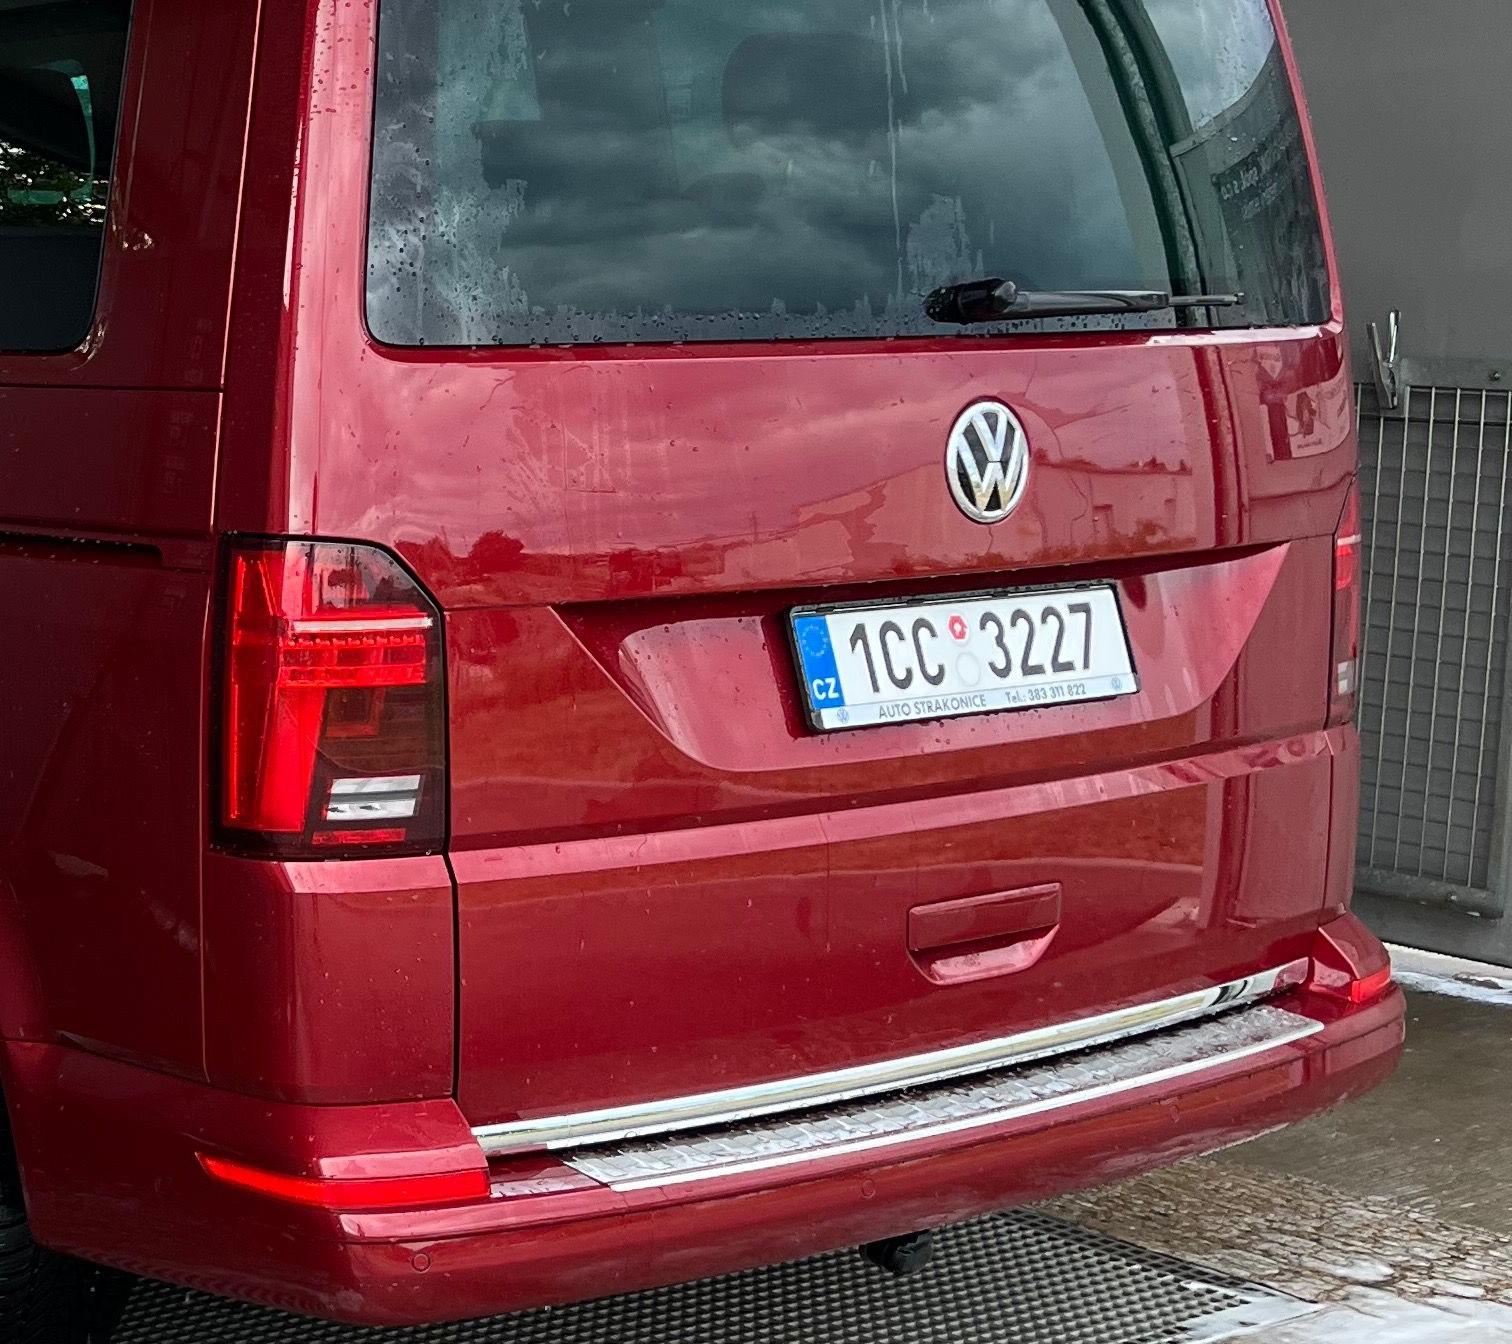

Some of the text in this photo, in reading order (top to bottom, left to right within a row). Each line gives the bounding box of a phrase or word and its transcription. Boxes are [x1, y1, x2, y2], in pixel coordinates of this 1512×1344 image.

[849, 602, 1092, 693] 1CC 3227
[812, 678, 839, 700] CZ
[879, 702, 912, 719] AUTO
[914, 694, 987, 715] STRAKONICE
[1028, 687, 1048, 702] 383
[1049, 685, 1065, 698] 311
[1067, 682, 1087, 697] 822
